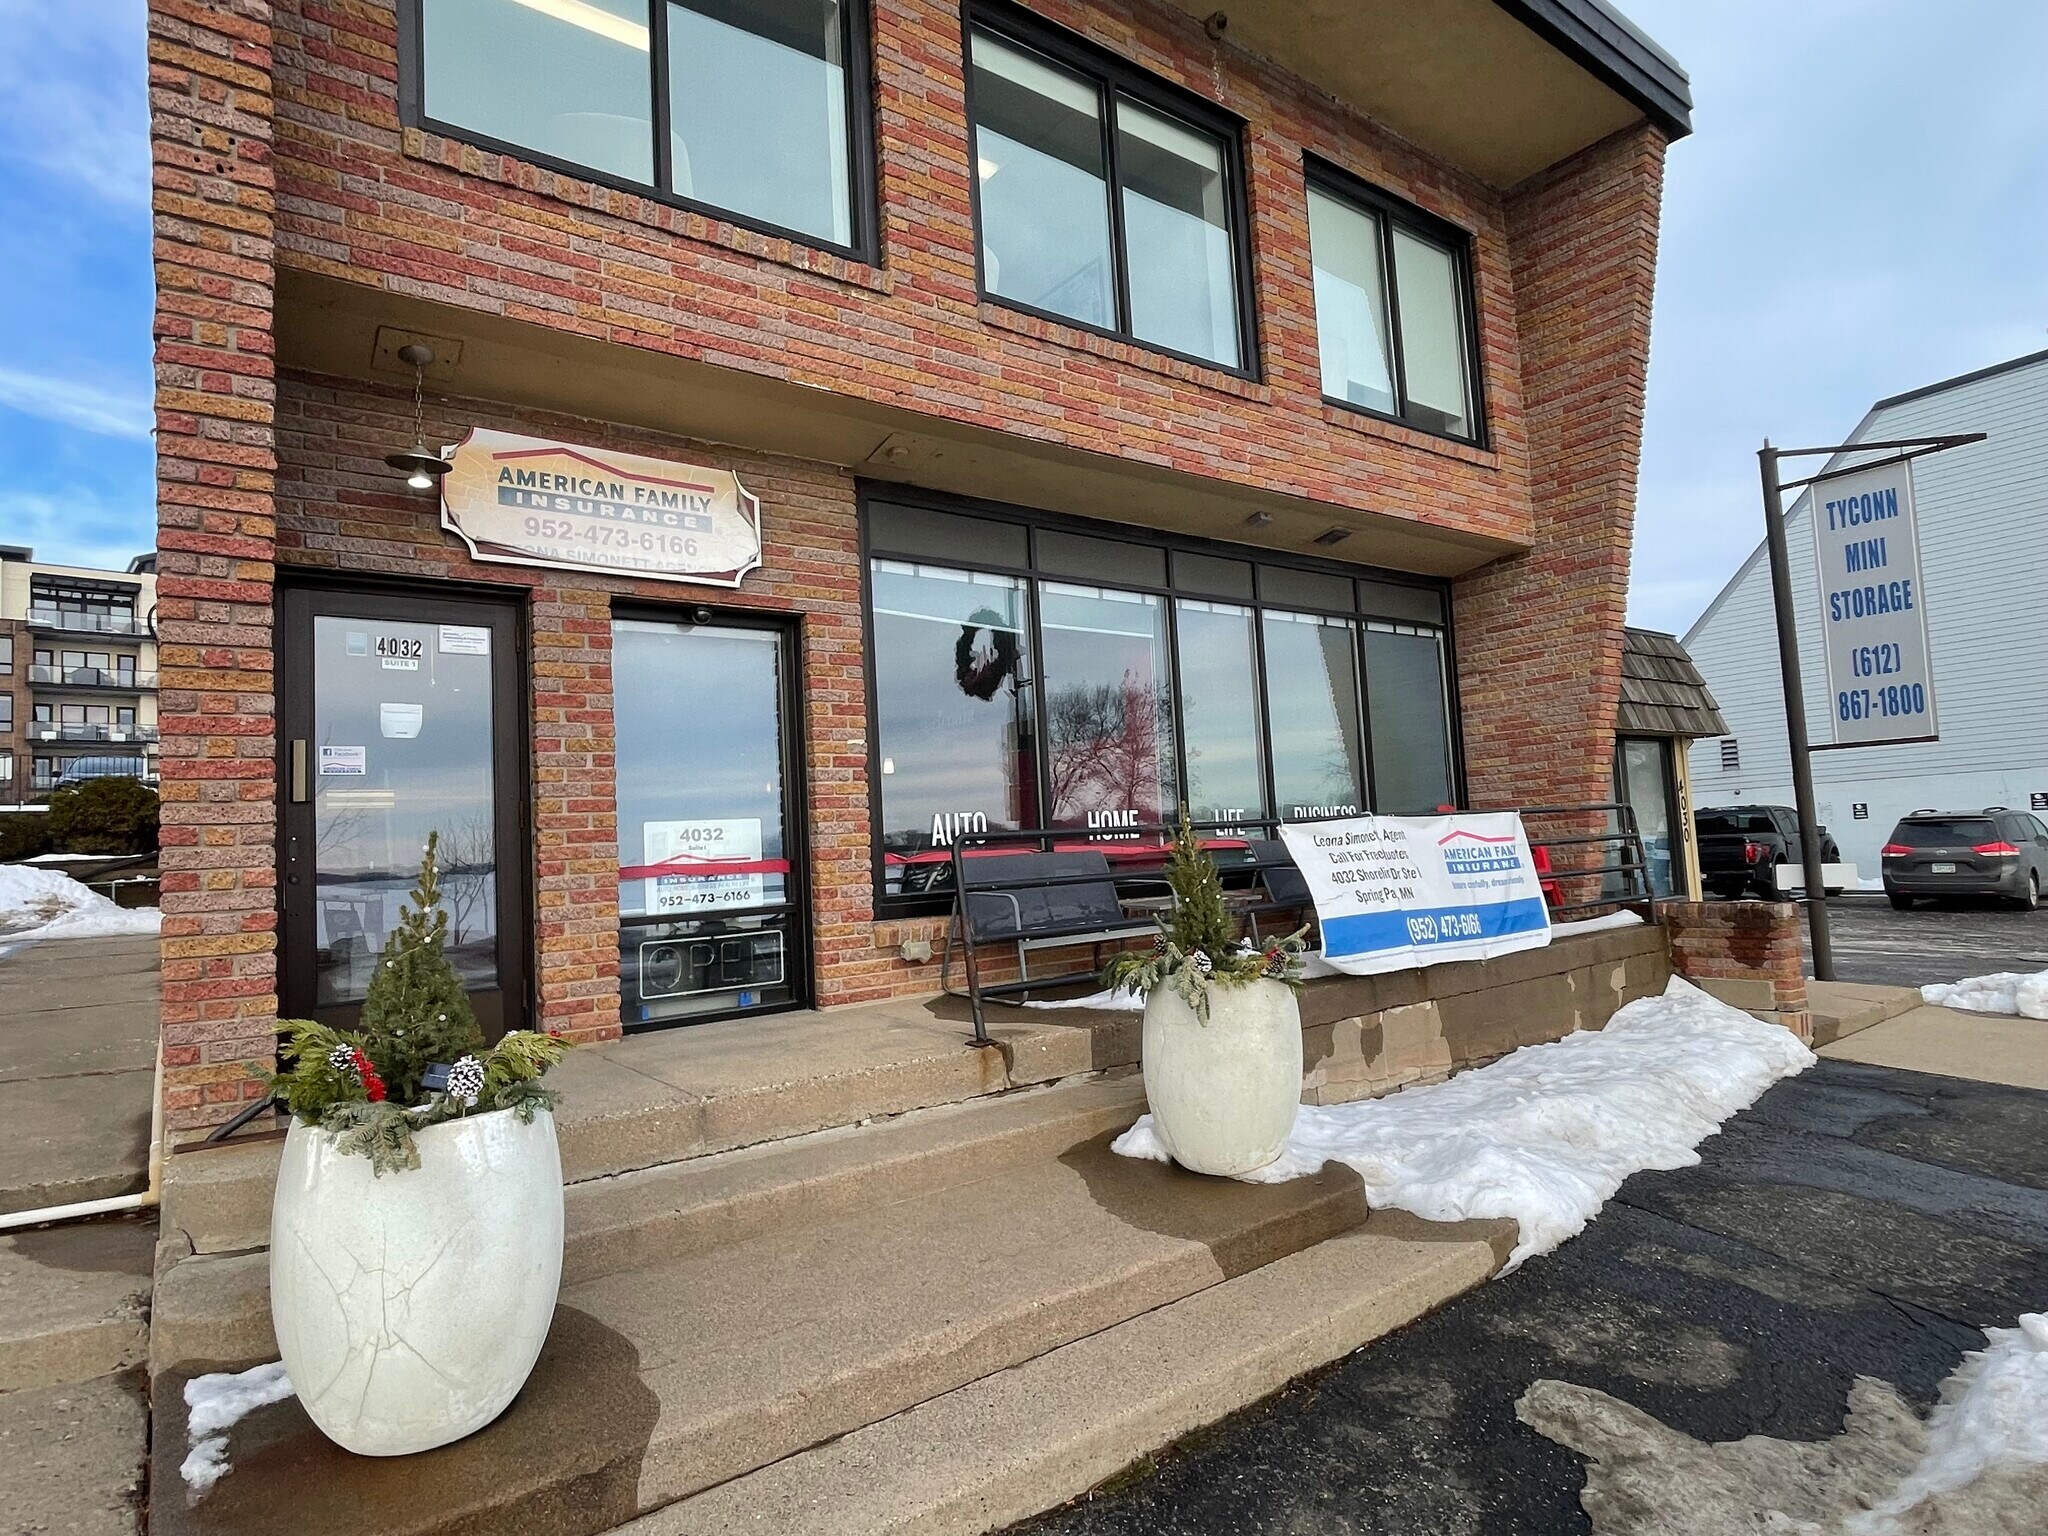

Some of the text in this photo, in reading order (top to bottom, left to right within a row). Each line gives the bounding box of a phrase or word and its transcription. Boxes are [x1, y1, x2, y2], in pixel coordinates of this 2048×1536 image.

[498, 466, 712, 514] AMERICAN FAMILY
[515, 491, 698, 528] INSURANCE
[1826, 487, 1899, 531] TYCONN
[524, 516, 698, 557] 952-473-6166
[1845, 536, 1888, 573] MINI
[1830, 579, 1914, 622] STORAGE
[377, 637, 422, 658] 4032
[1852, 642, 1902, 678] (612)
[384, 659, 410, 667] SUITE
[1839, 682, 1925, 721] 867-1800
[680, 828, 724, 843] 4032
[931, 811, 988, 847] AUTO
[1087, 809, 1140, 841] HOME
[1214, 808, 1246, 837] LIFE
[1313, 834, 1343, 848] Leona
[1444, 846, 1493, 860] AMERICAN
[1328, 851, 1348, 864] Call
[1347, 849, 1365, 863] For
[663, 873, 744, 885] INSURANCE
[1332, 870, 1357, 885] 4032
[1390, 867, 1401, 880] Dr
[1401, 866, 1417, 880] Ste
[660, 889, 751, 908] 952-473-6166
[1355, 888, 1384, 905] Spring
[1399, 886, 1415, 900] MN
[1406, 912, 1482, 945] (952) 473-6166
